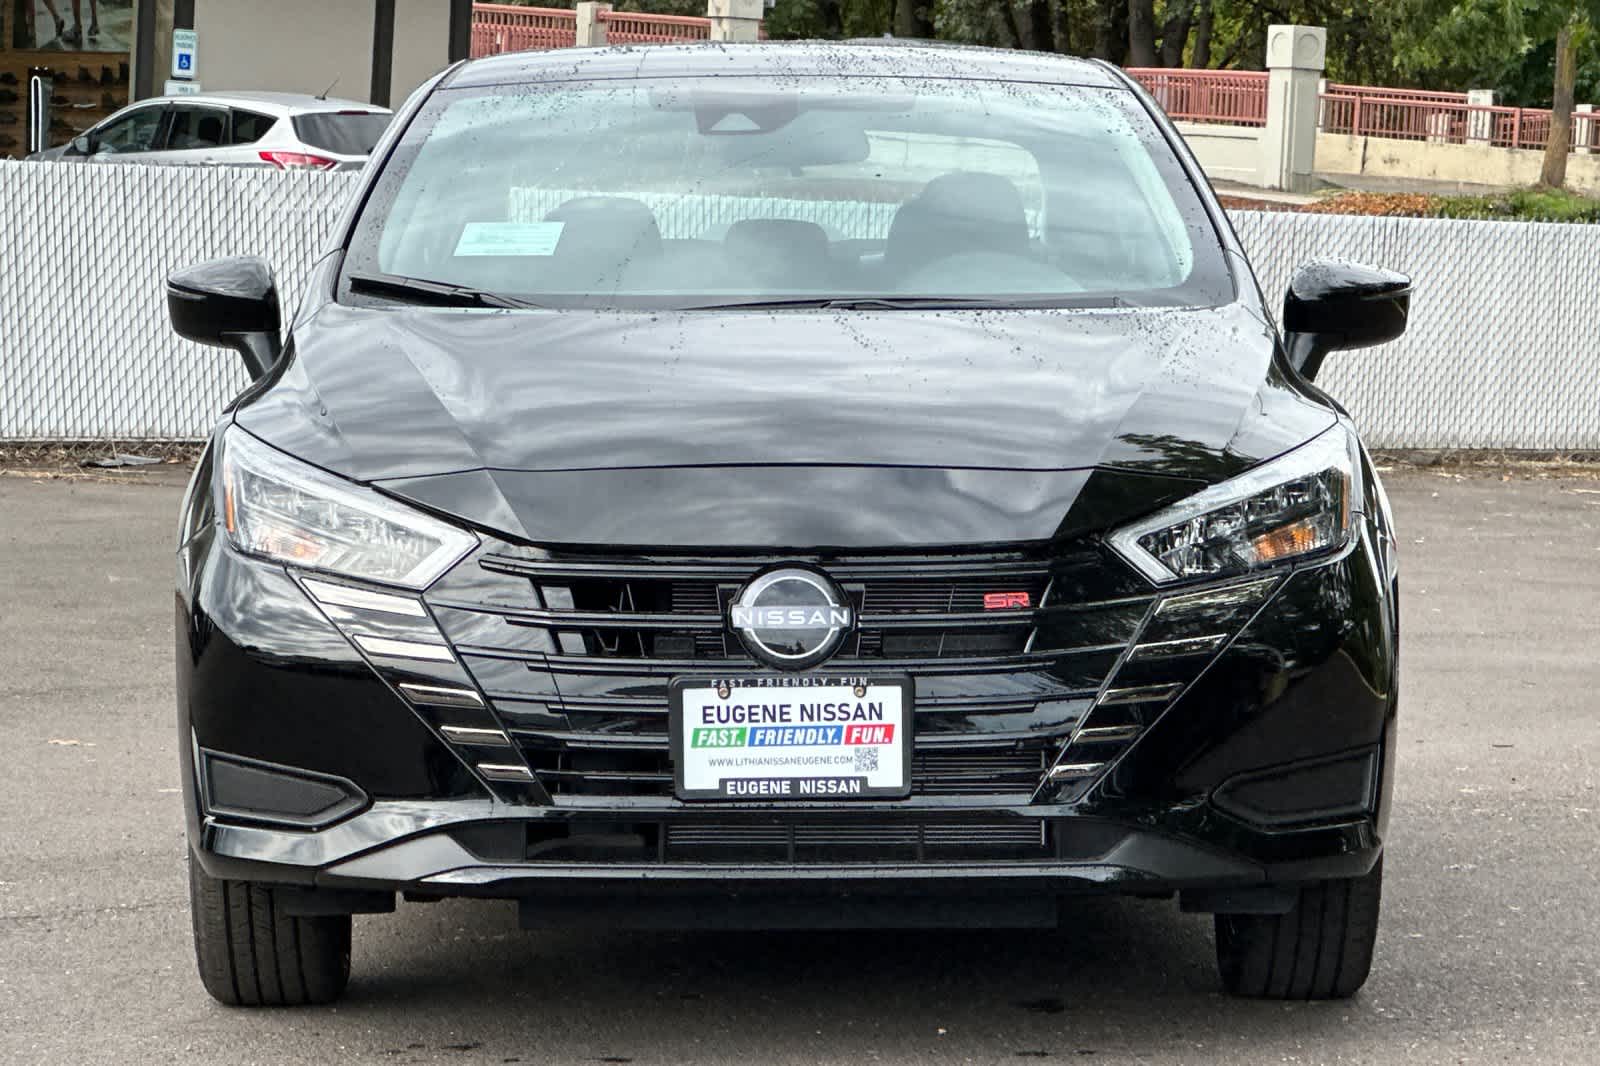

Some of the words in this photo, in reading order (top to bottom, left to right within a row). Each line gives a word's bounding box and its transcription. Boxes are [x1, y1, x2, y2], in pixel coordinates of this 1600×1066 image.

[984, 592, 1030, 608] SR
[736, 610, 848, 625] NISSAN
[711, 679, 750, 688] FAST.
[757, 678, 834, 687] FRIENDLY.
[841, 677, 874, 686] FUN.
[702, 704, 792, 724] EUGENE
[800, 702, 882, 722] NISSAN
[697, 728, 742, 747] FAST.
[753, 727, 840, 746] FRIENDLY.
[850, 726, 890, 744] FUN.
[726, 780, 791, 795] EUGENE
[800, 779, 860, 794] NISSAN
